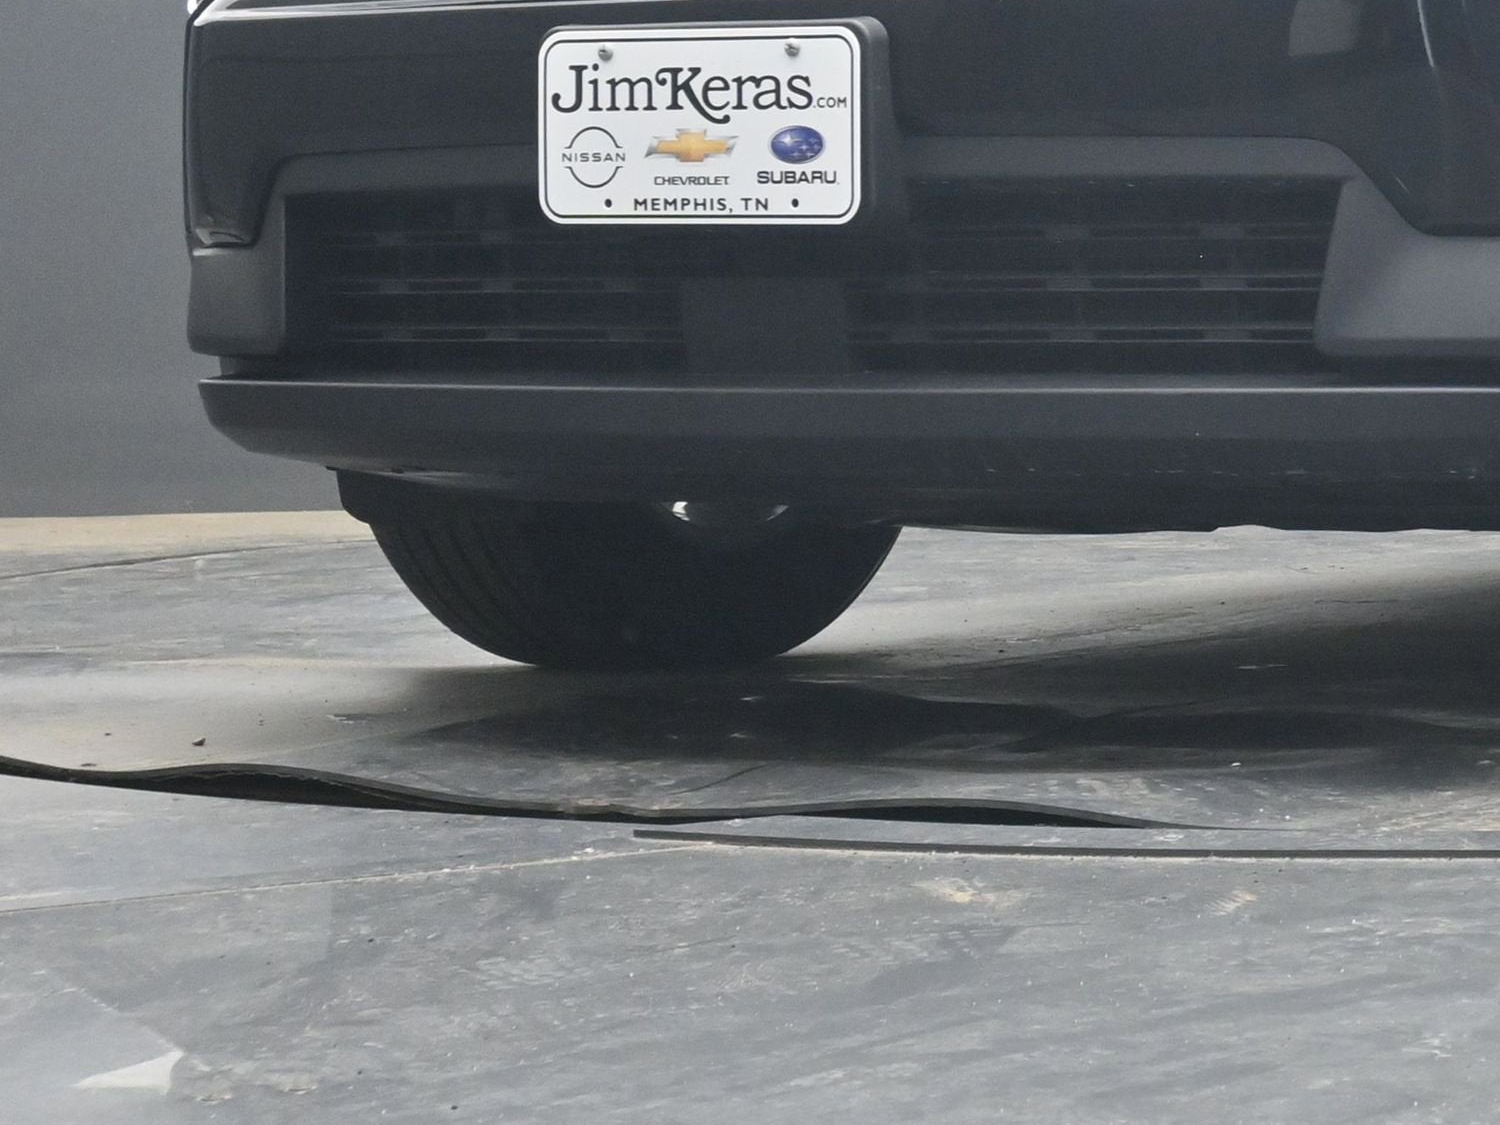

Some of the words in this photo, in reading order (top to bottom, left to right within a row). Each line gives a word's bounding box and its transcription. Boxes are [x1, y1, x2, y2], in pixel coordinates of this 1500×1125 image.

[561, 151, 627, 164] NISSAN
[653, 175, 730, 186] CHEVROLET
[756, 169, 838, 185] SUBARU
[633, 197, 733, 214] MEMPHIS,
[741, 197, 769, 211] TN
